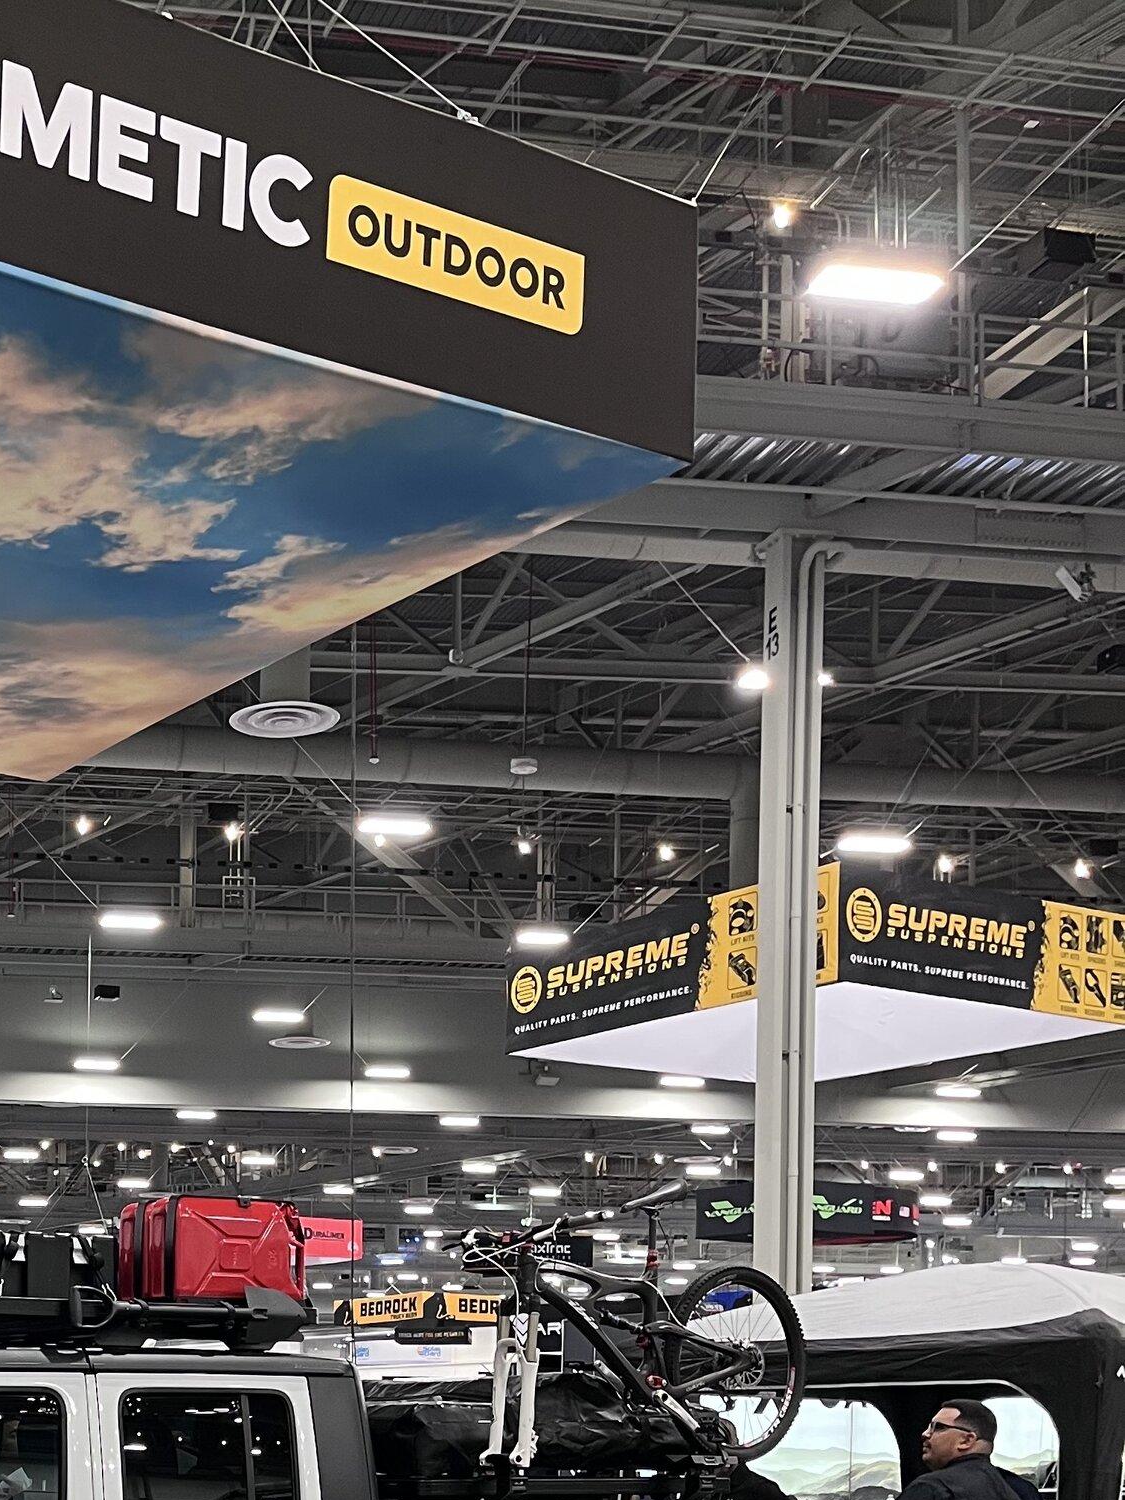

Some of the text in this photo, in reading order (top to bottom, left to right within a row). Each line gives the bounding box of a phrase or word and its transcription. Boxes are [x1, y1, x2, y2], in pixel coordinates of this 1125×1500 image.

[348, 204, 566, 311] OUTDOOR
[769, 606, 777, 633] E
[766, 634, 779, 660] 13
[887, 903, 1027, 949] SUPREME
[887, 927, 1024, 959] SUSPENSIONS
[546, 955, 687, 999] SUSPENSIONS
[547, 932, 690, 988] SUPREME
[850, 953, 1029, 990] QUALITY PARTS. SUPREME PERFORMANCE.
[514, 986, 693, 1035] QUALITY PARTS. SUPREME PERFORMANCE.
[360, 1297, 417, 1316] BEDROCK
[458, 1298, 497, 1314] BEDR
